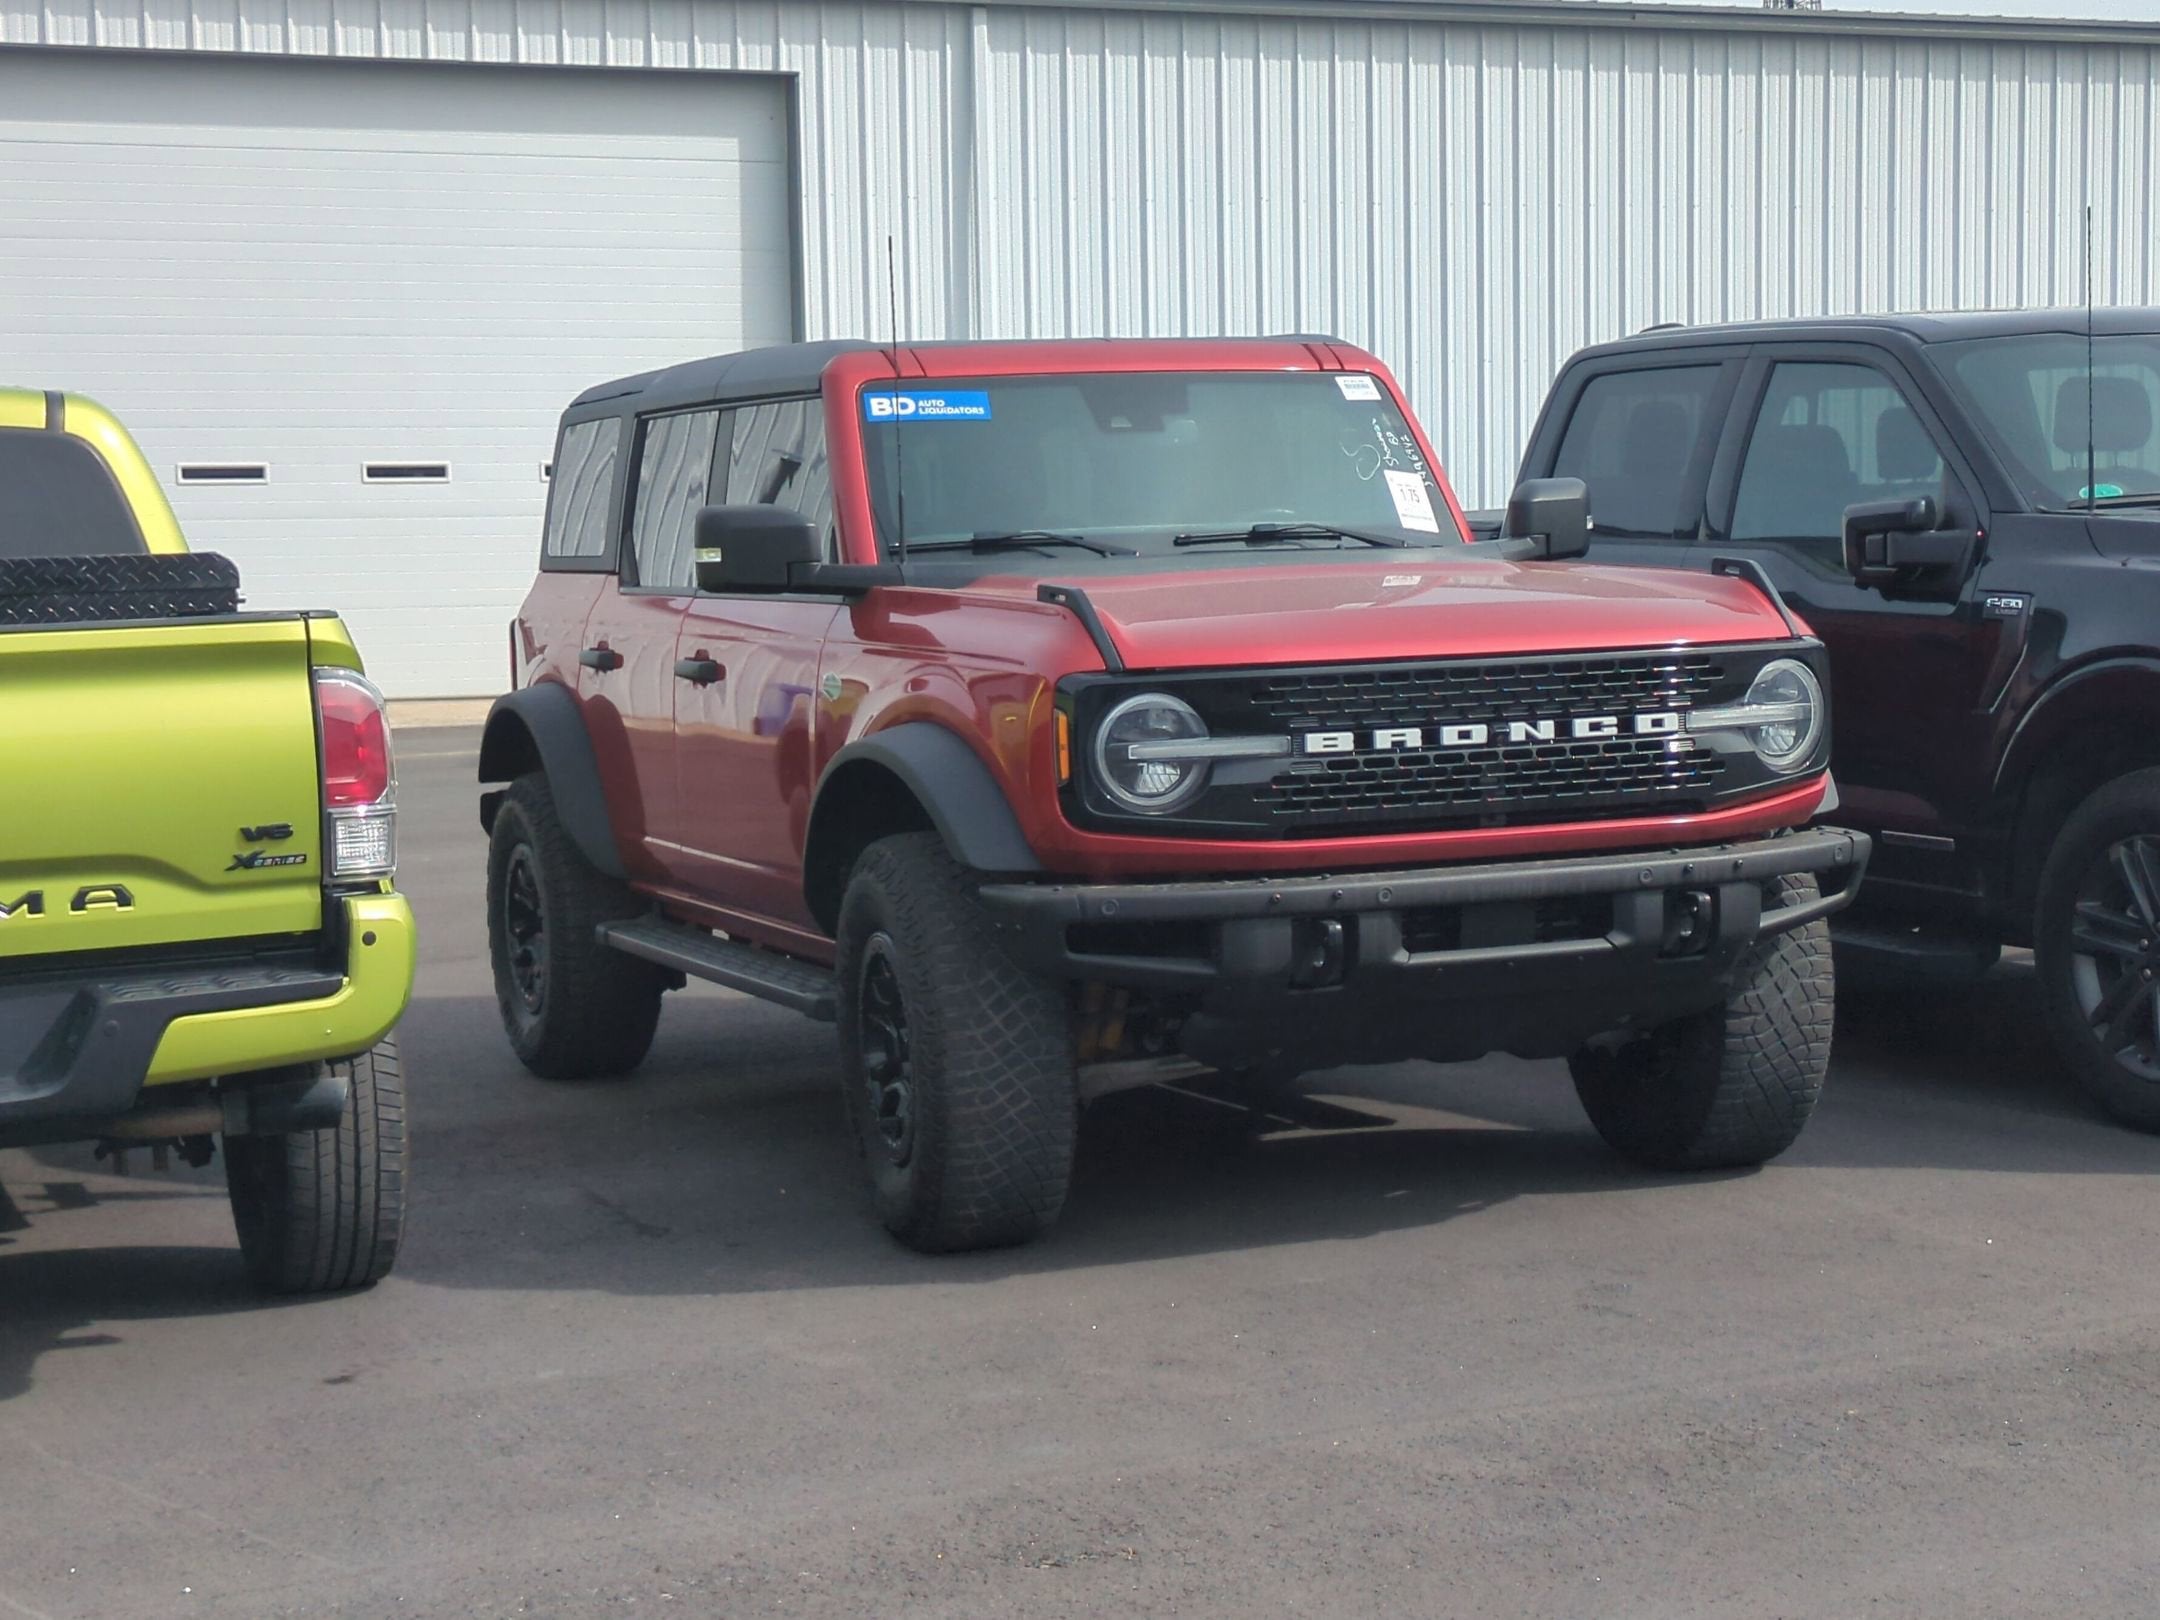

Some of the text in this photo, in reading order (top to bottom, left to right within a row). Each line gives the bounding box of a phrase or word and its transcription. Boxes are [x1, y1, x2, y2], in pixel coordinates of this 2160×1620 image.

[870, 397, 916, 416] BD
[918, 399, 945, 407] AUTO
[918, 406, 985, 415] LIQUIDATORS
[1304, 711, 1680, 753] BRONCO
[239, 822, 294, 842] V6
